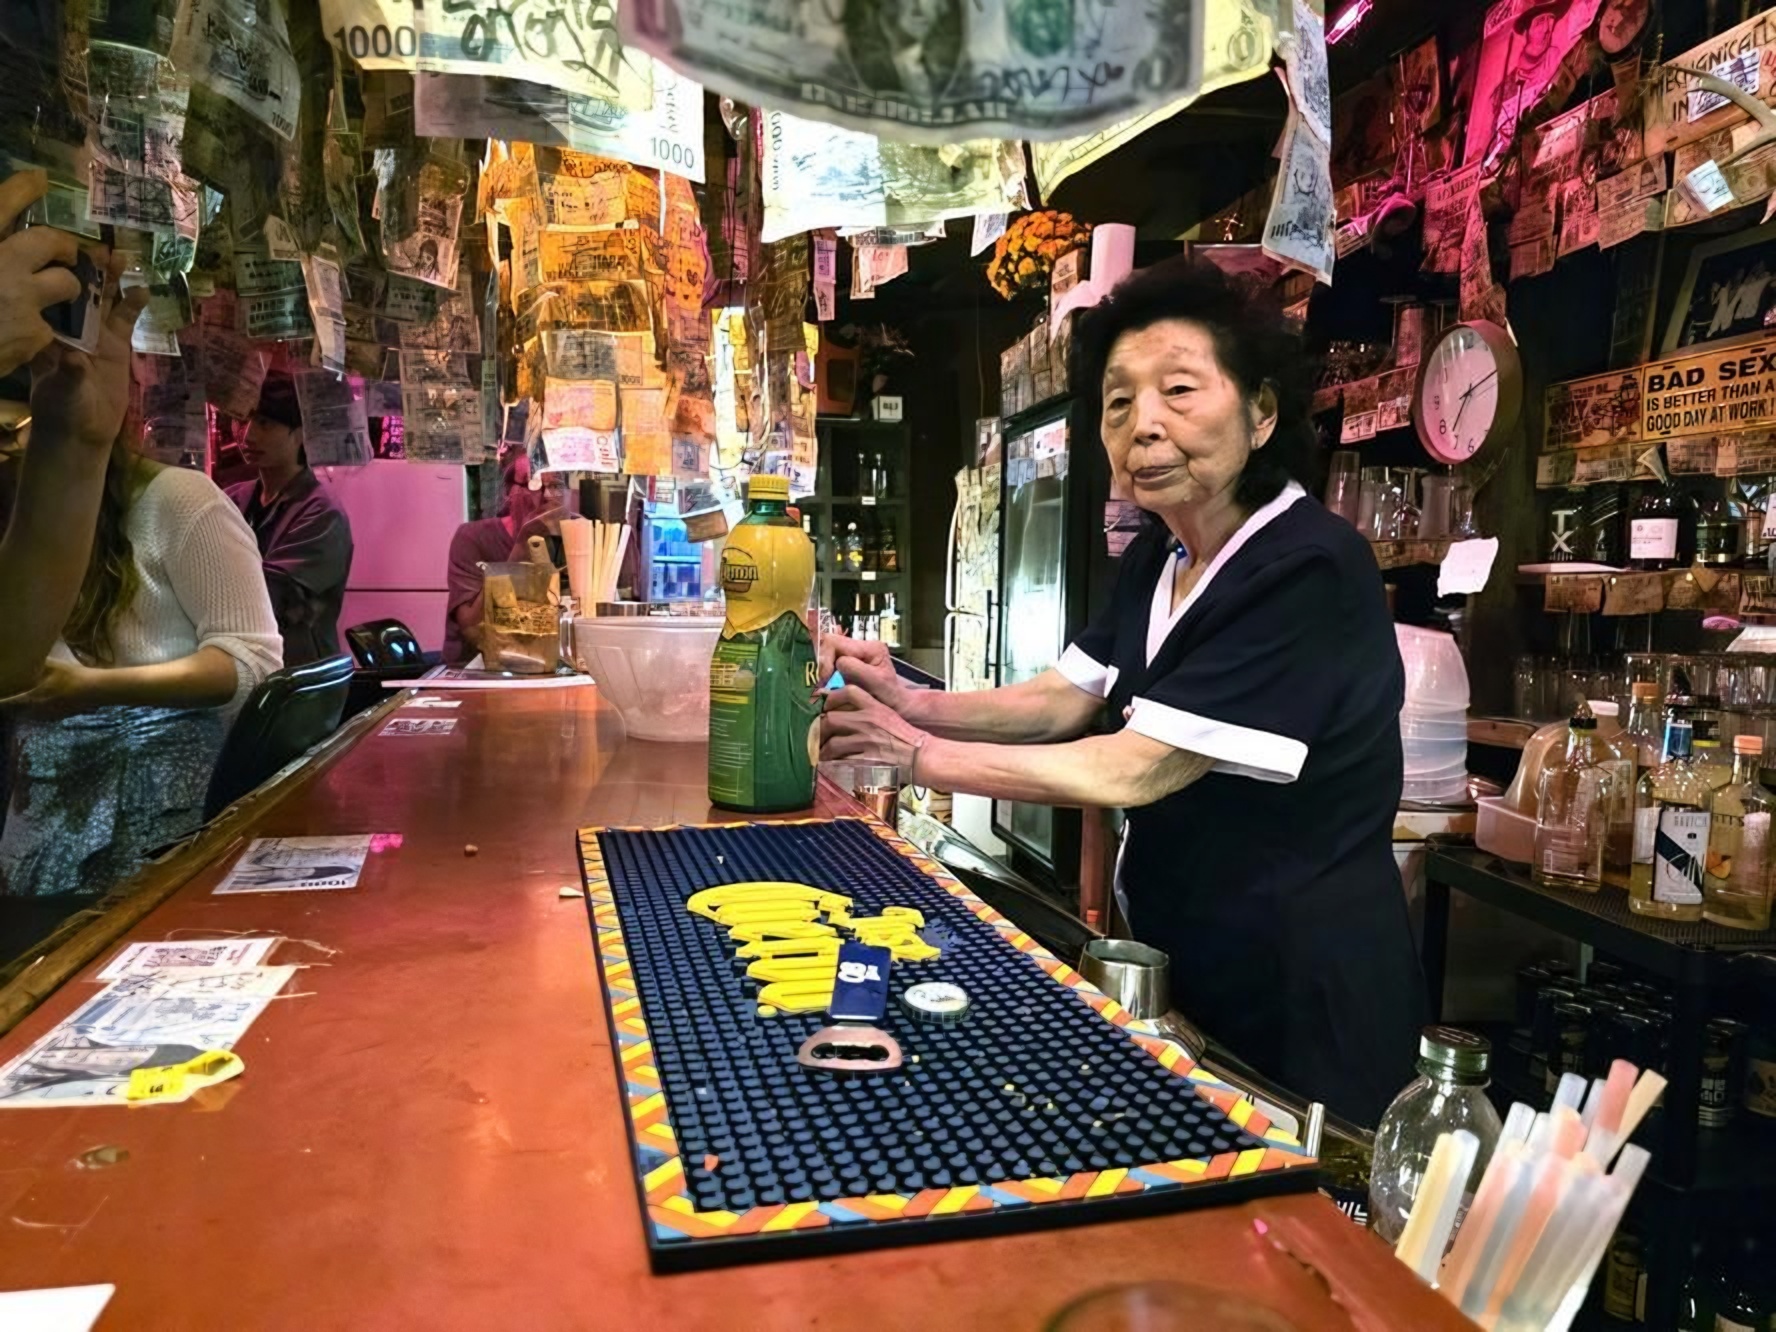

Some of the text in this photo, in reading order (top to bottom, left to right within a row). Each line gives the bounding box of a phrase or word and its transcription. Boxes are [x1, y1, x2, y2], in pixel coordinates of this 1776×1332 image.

[334, 25, 416, 59] 1000
[650, 135, 695, 170] 1000
[1649, 354, 1776, 394] BAD SEX
[1647, 378, 1776, 412] IS BETTER THAN A
[1647, 411, 1681, 432] GOOD
[1684, 406, 1706, 428] DAY
[1709, 403, 1725, 423] AT
